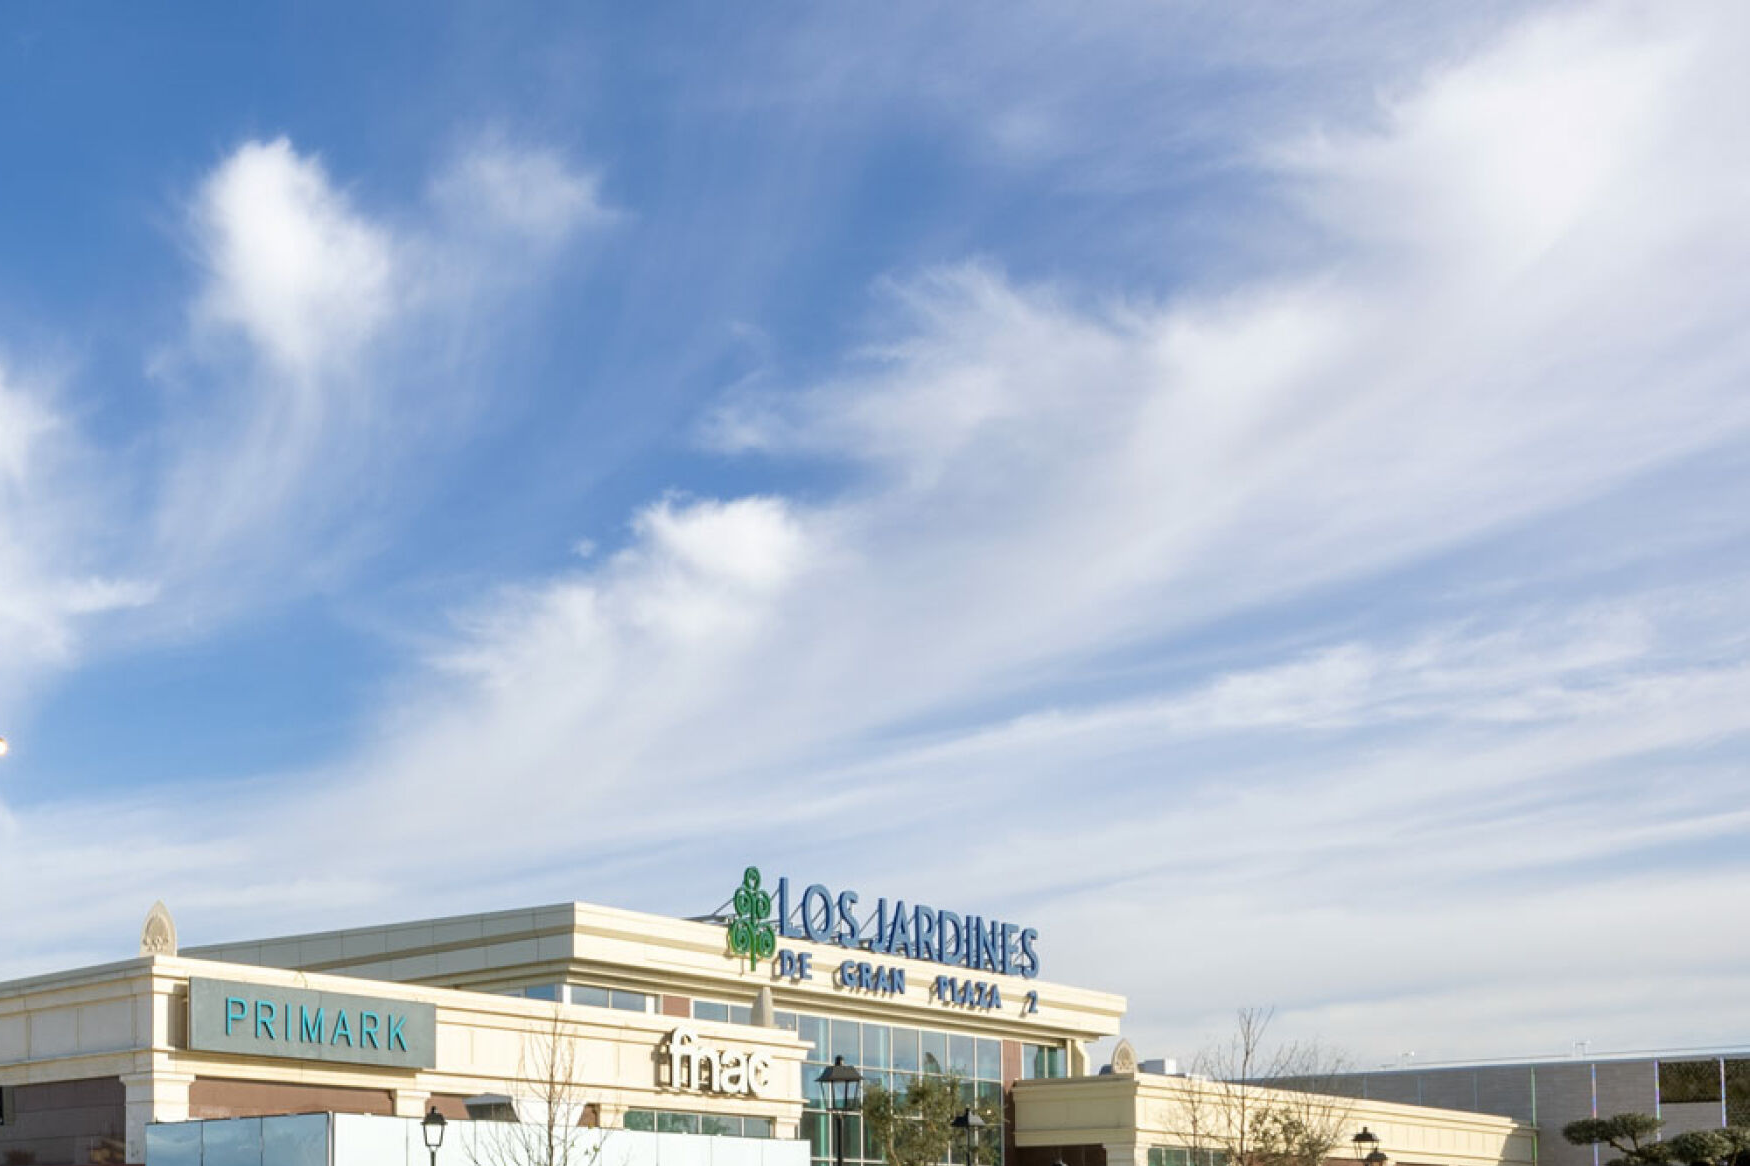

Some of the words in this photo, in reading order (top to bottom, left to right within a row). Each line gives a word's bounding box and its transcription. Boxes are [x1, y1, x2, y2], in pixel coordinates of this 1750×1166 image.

[778, 876, 859, 949] LOS
[868, 897, 1039, 979] JARDINES
[779, 949, 813, 980] DE
[840, 959, 906, 995] GRAN
[936, 974, 1002, 1010] PLAZA
[1025, 990, 1039, 1014] 2
[225, 996, 408, 1052] PRIMARK
[669, 1025, 771, 1098] fnac
